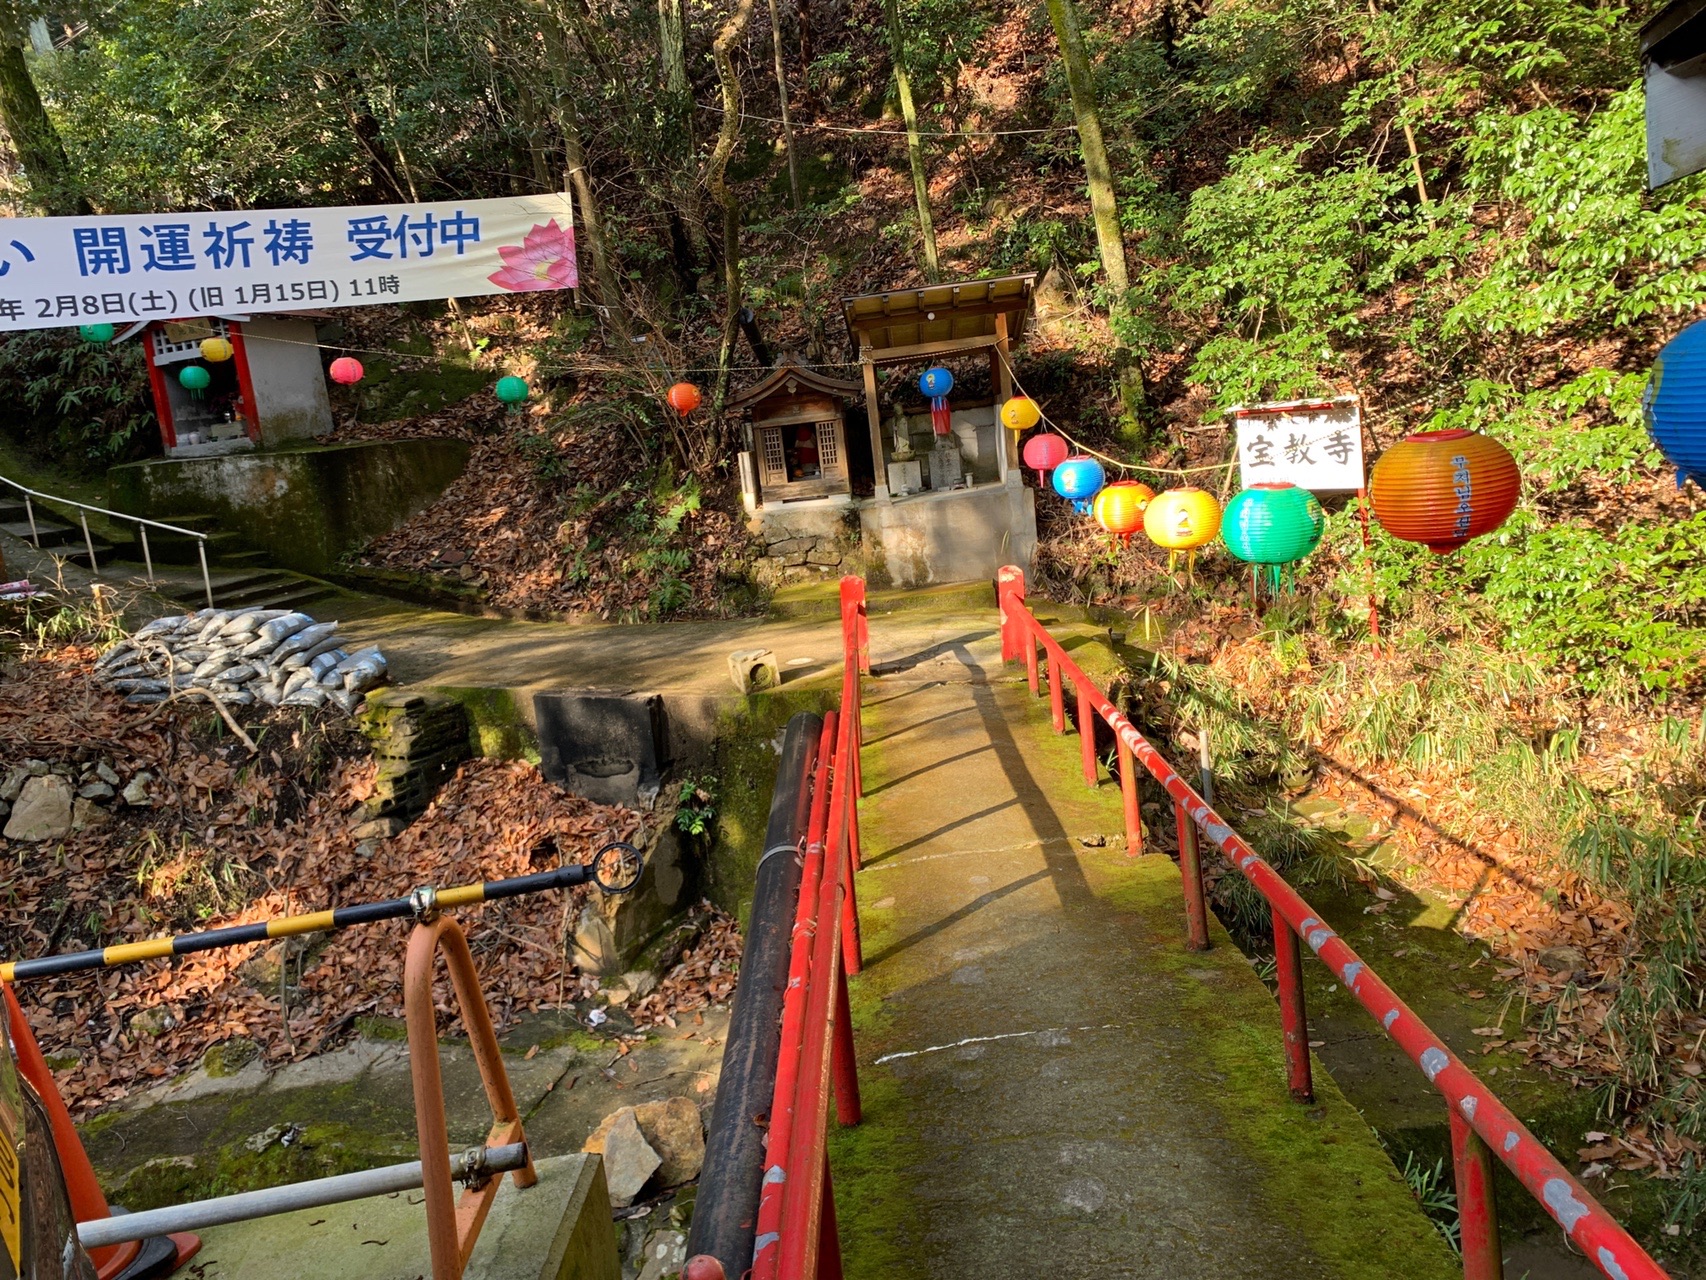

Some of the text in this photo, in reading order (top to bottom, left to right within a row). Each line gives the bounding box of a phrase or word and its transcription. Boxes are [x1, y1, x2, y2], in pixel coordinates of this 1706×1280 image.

[73, 218, 314, 277] 開運祈祷
[347, 210, 480, 262] 受付中
[0, 298, 25, 322] 年
[35, 290, 178, 319] 2月8日(土)
[350, 274, 401, 297] 11時
[1246, 430, 1355, 468] 宝教寺
